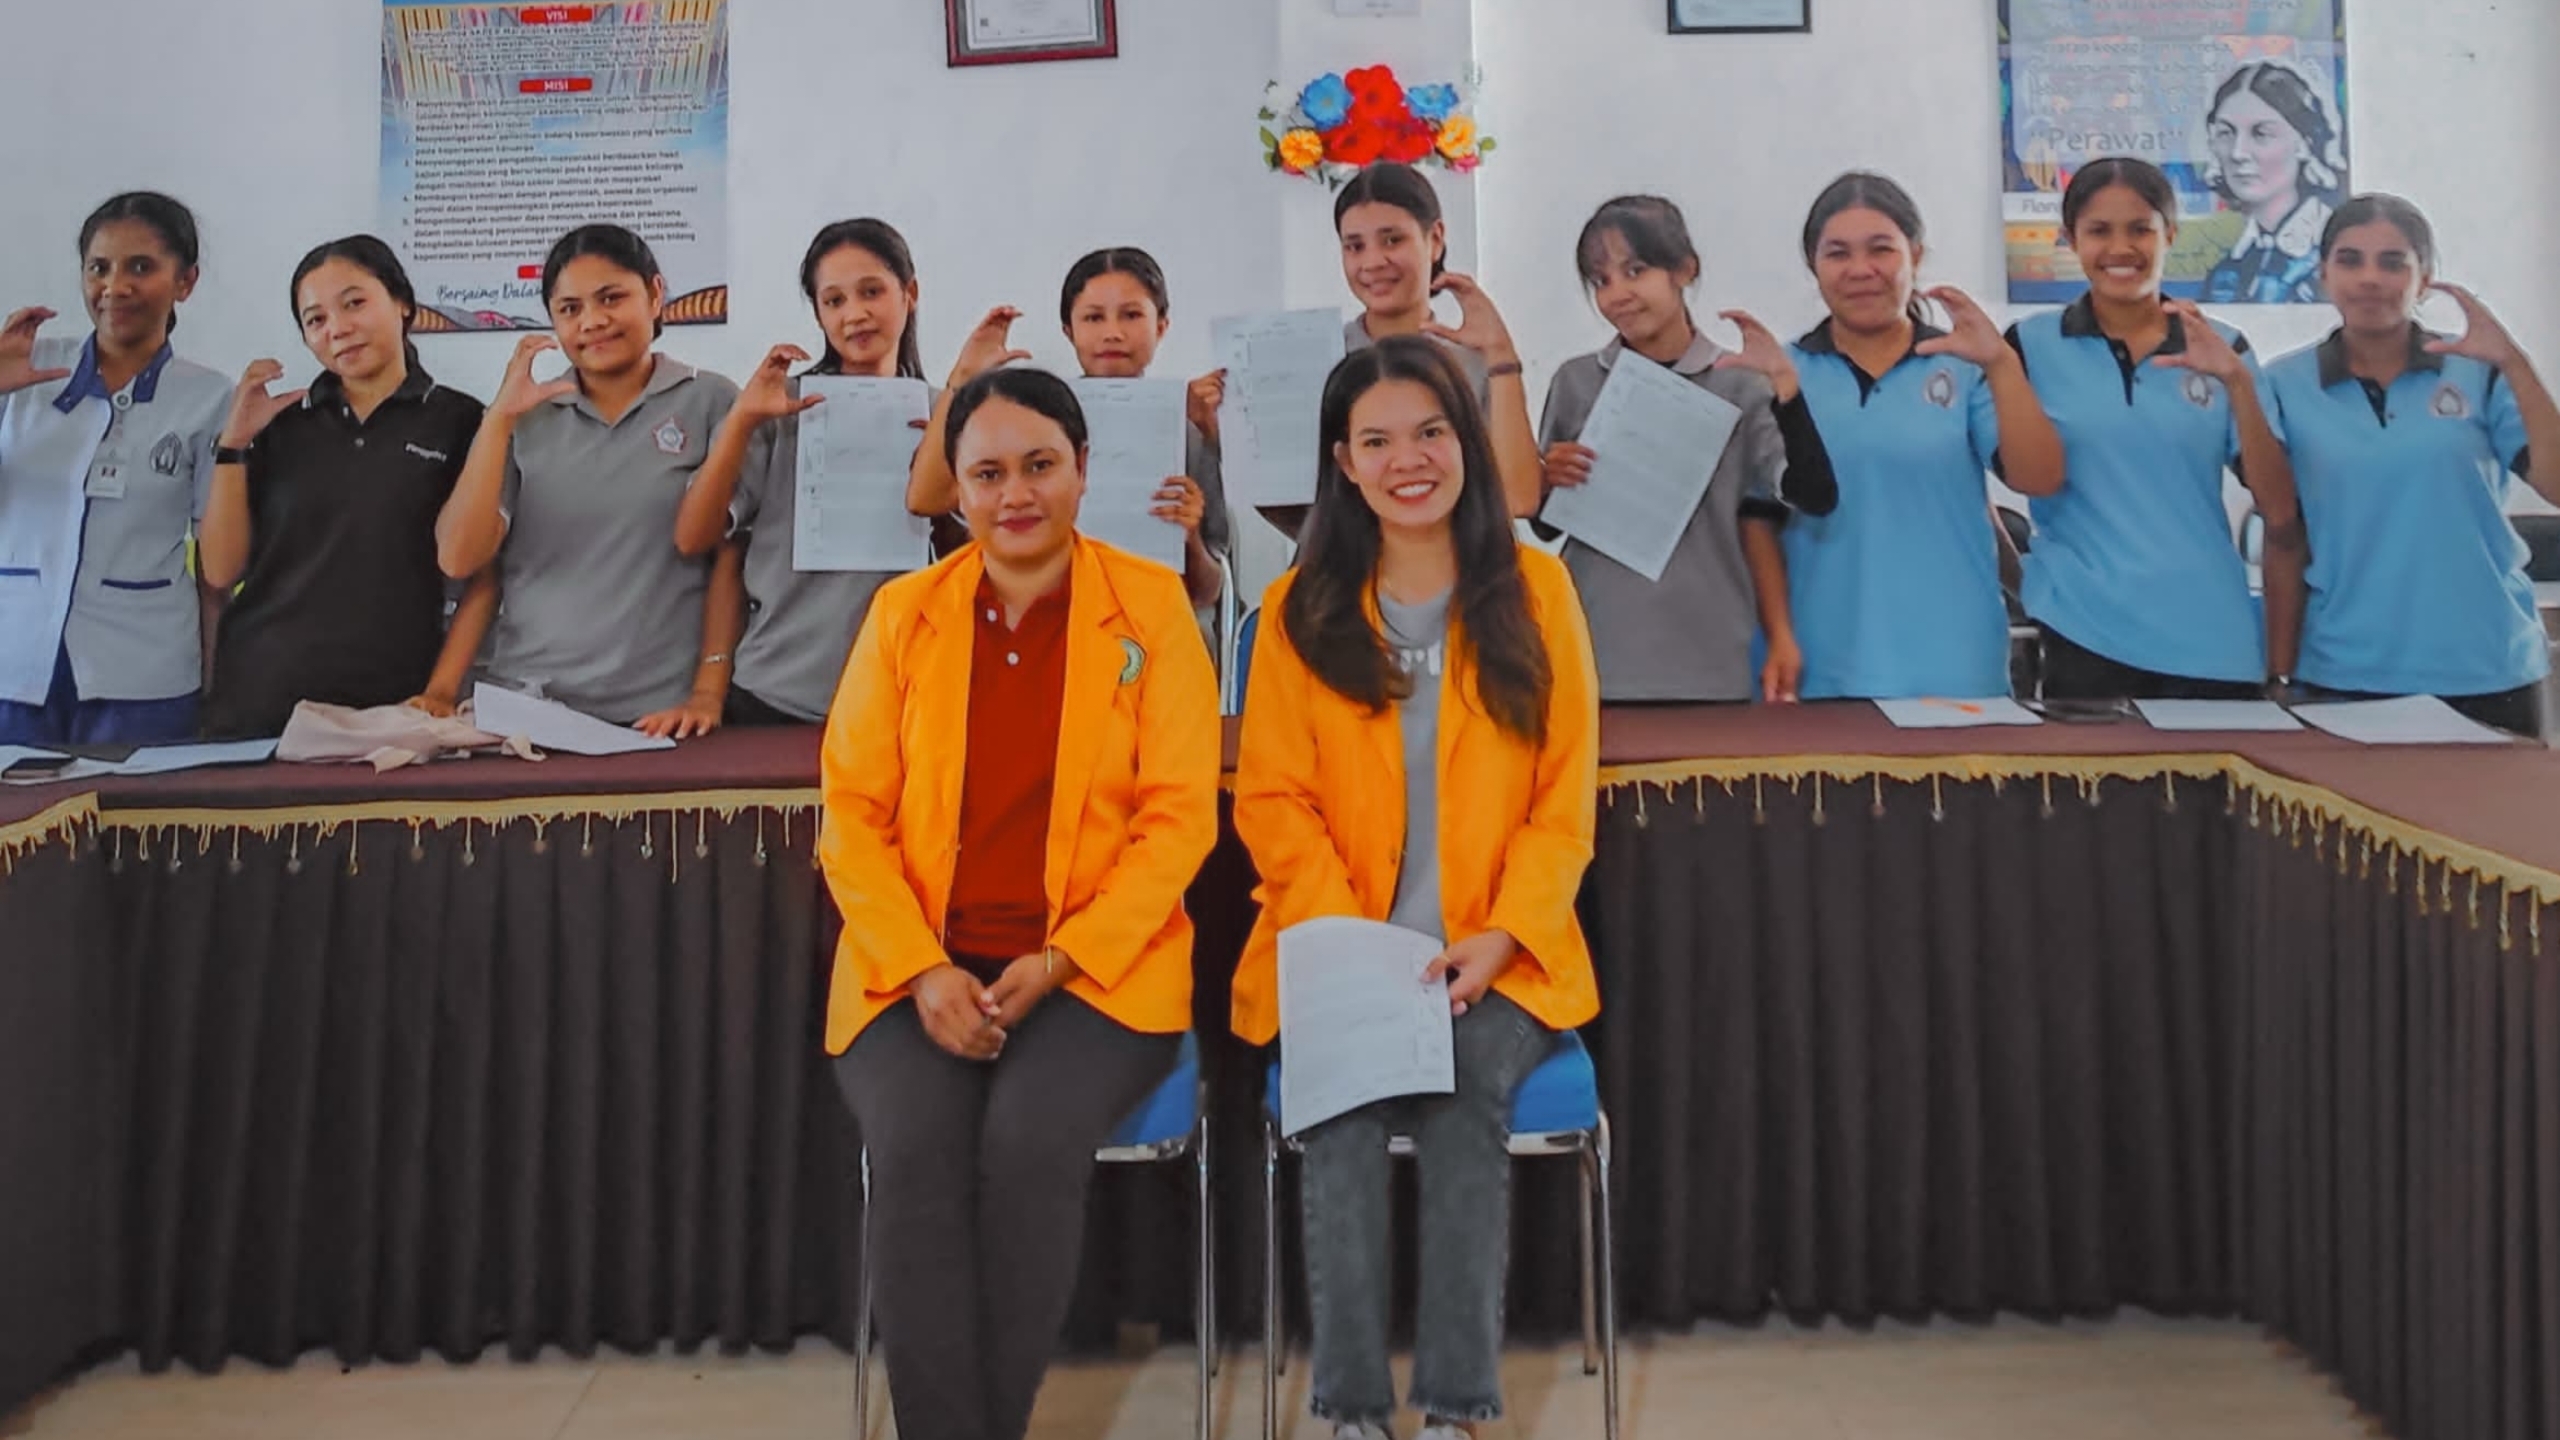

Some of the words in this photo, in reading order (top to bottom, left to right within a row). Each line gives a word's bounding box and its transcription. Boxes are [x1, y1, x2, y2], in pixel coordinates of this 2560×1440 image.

[546, 10, 568, 21] VISI
[544, 80, 569, 91] MISI
[415, 156, 496, 167] Menyelenggarakan
[414, 215, 487, 226] Mengembangkan
